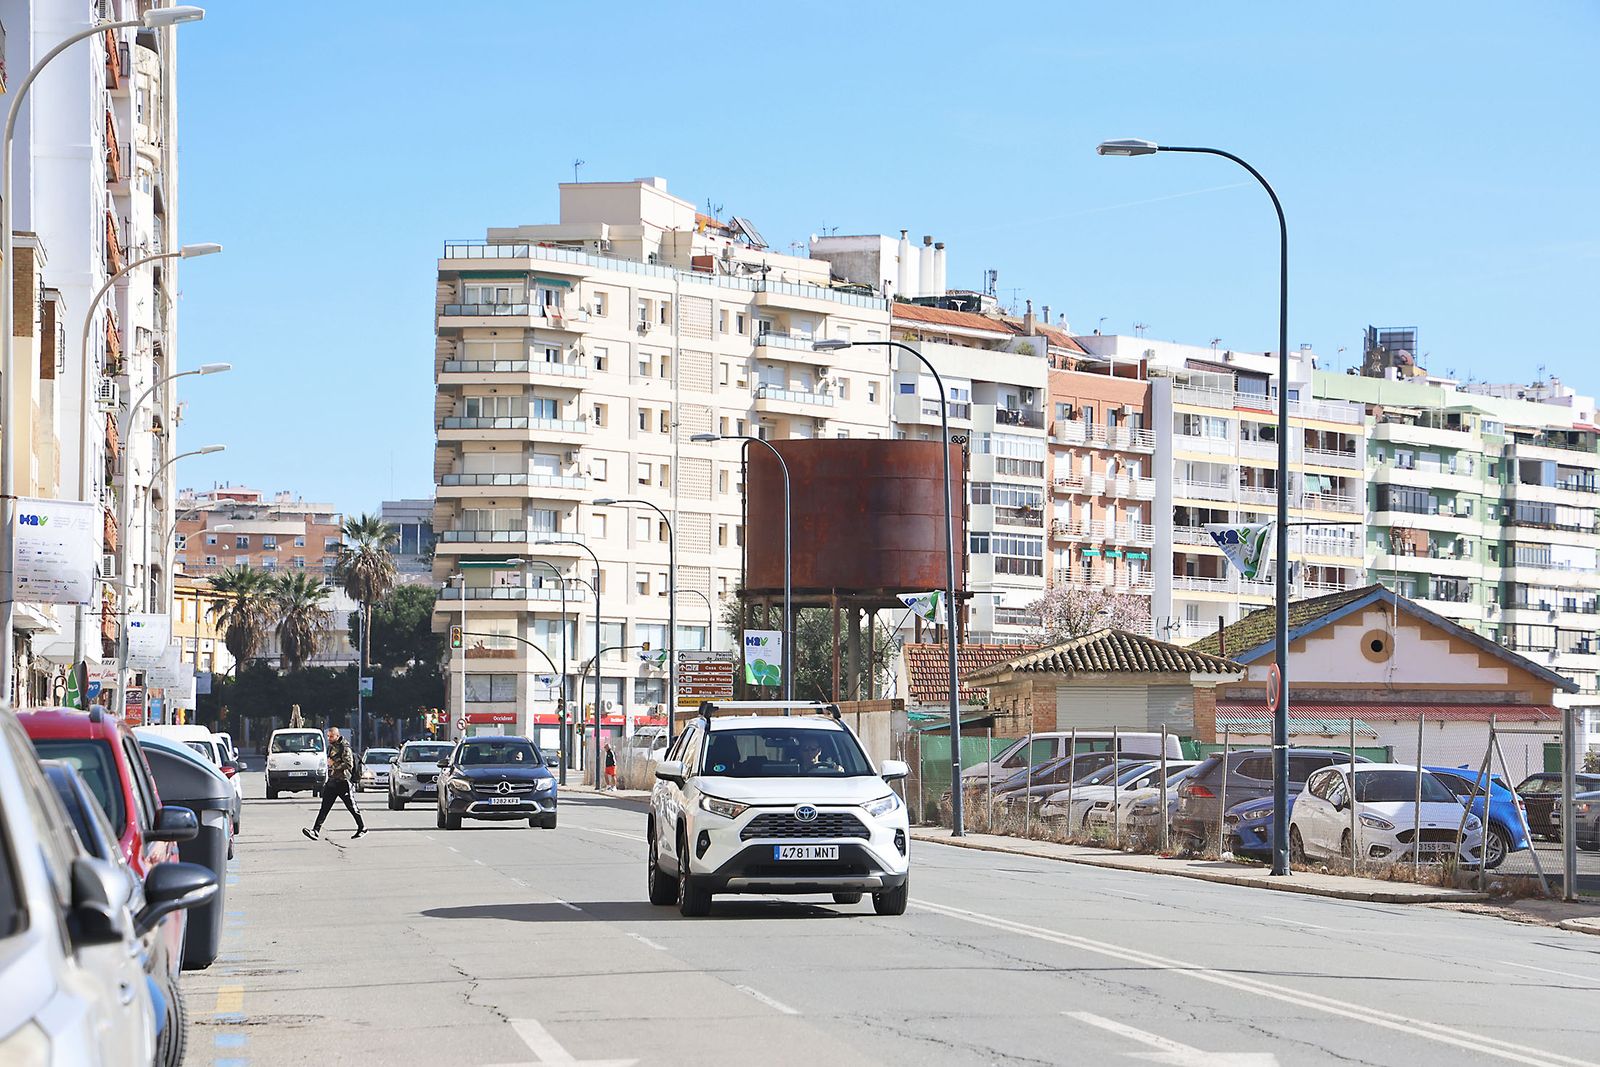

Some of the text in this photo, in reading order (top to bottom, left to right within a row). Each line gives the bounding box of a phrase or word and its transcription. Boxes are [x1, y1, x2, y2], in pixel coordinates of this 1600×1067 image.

[20, 514, 48, 527] H2V
[746, 636, 768, 646] H2V
[782, 847, 836, 858] 4781 MNT
